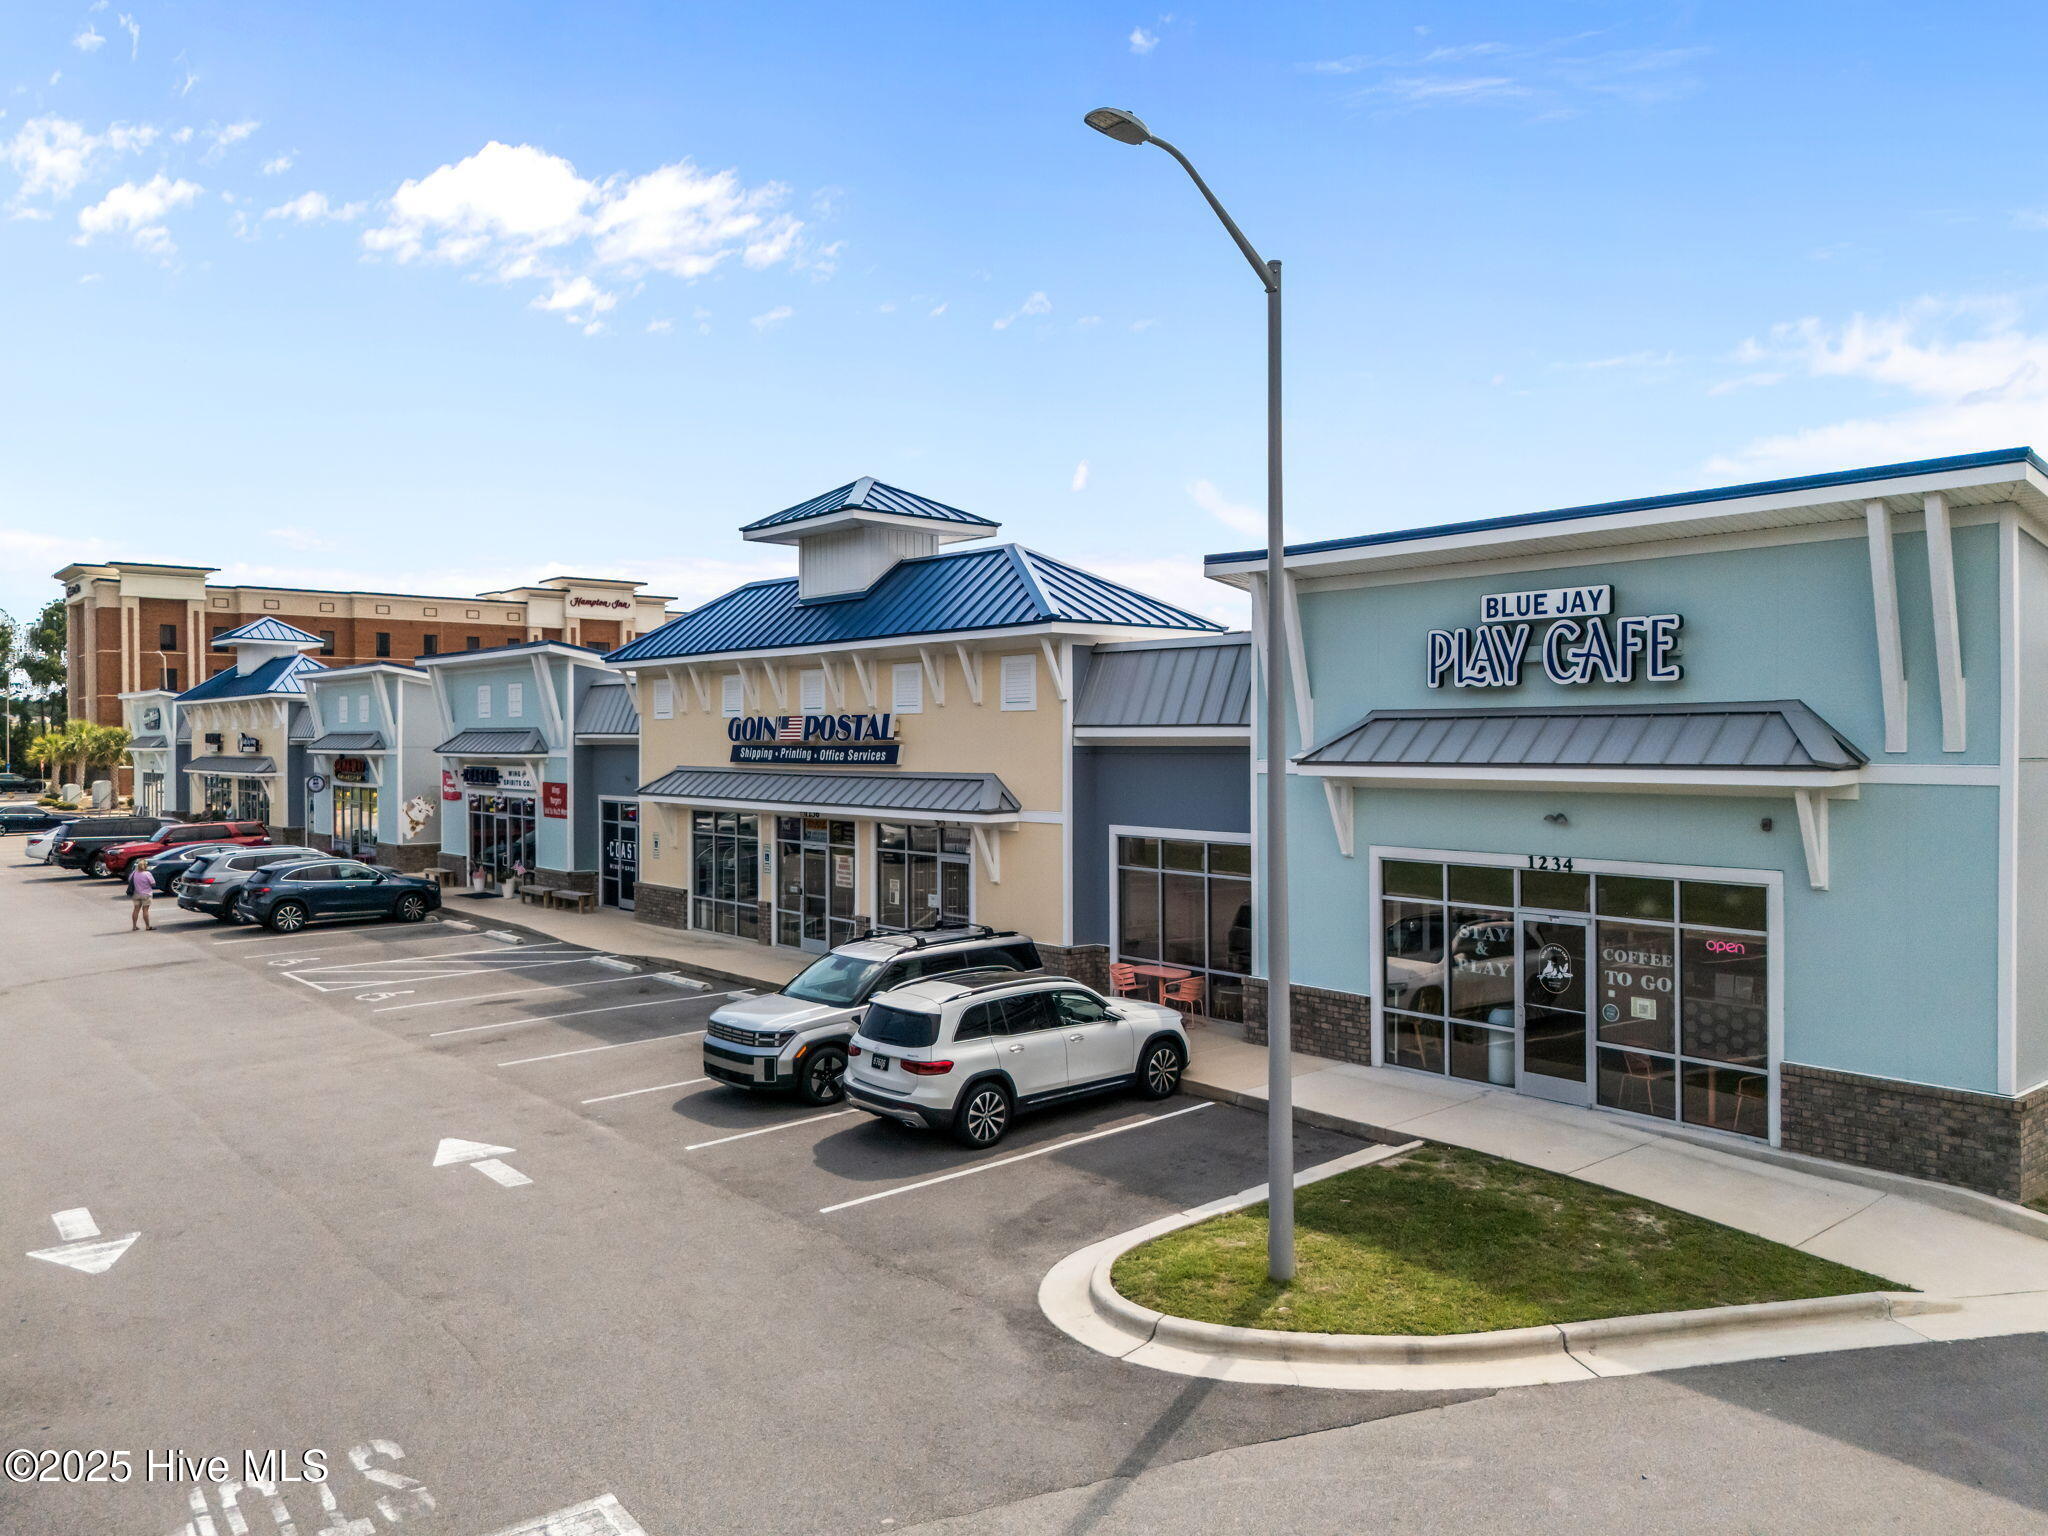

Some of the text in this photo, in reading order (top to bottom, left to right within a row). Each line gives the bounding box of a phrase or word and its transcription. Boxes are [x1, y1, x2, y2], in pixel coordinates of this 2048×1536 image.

[570, 597, 630, 609] Hampton Inn
[1486, 588, 1604, 618] BLUE JAY
[1427, 614, 1681, 688] PLAY CAFE
[803, 713, 895, 742] POSTAL
[740, 747, 886, 761] Shipping Printing Office Services
[1528, 855, 1573, 873] 1234
[1459, 924, 1509, 942] STAY
[1475, 941, 1489, 956] &
[1705, 940, 1745, 955] open
[1602, 948, 1673, 968] COFFEE
[1457, 958, 1510, 977] PLAY
[1604, 970, 1672, 993] TO GO
